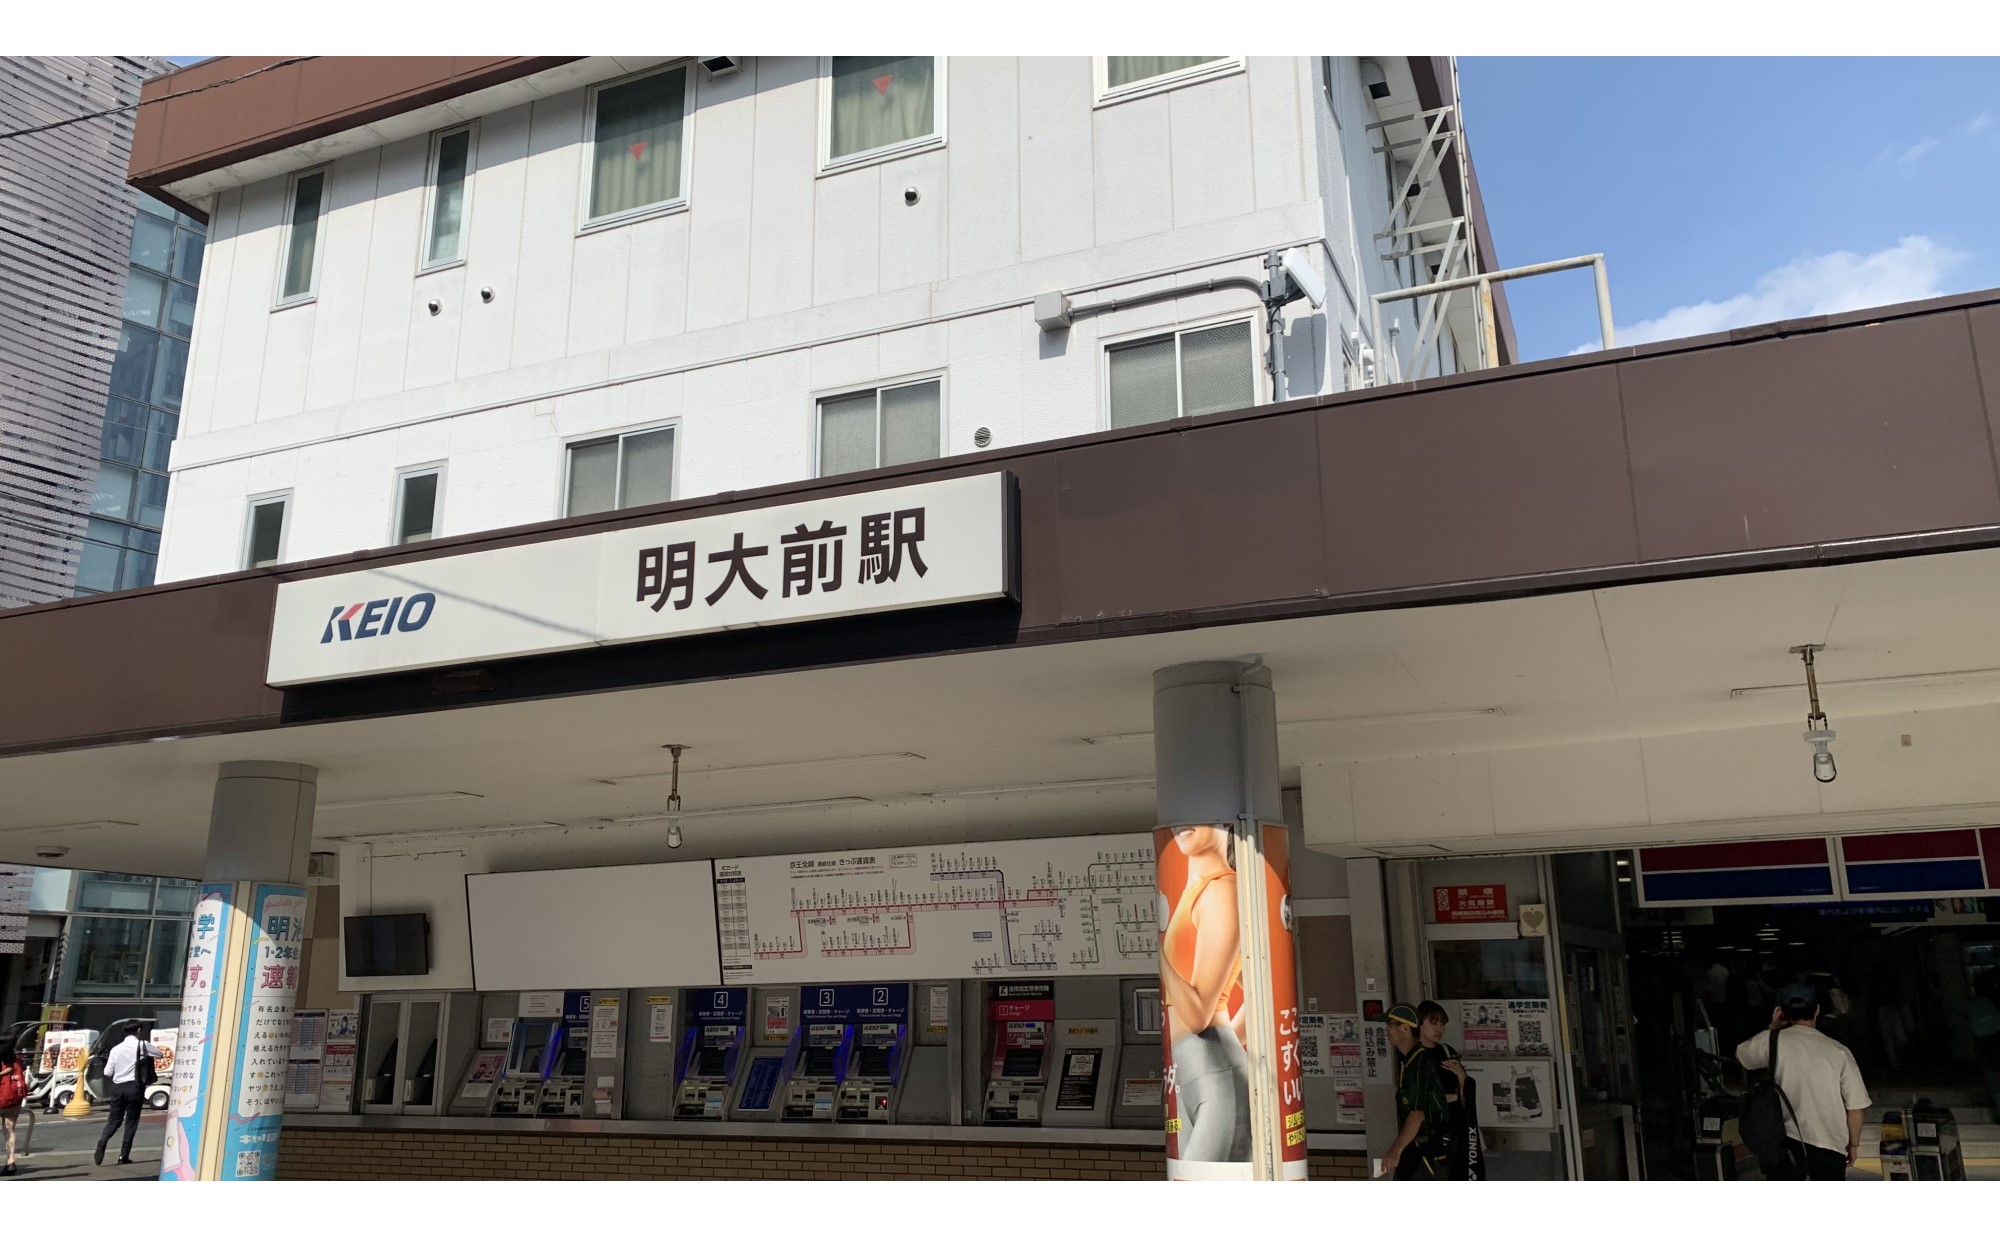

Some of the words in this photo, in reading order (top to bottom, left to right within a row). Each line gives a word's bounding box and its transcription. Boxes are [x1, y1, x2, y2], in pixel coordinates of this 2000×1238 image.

[635, 506, 930, 612] 明大前駅
[320, 592, 436, 643] KEIO
[583, 998, 590, 1009] 5
[717, 994, 725, 1005] 4
[823, 991, 831, 1004] 3
[877, 990, 885, 1002] 2
[1299, 1016, 1325, 1025] 定期券
[1364, 1027, 1377, 1077] 持込み禁止
[1376, 1027, 1387, 1057] 危険物
[1468, 1126, 1478, 1166] YONEX
